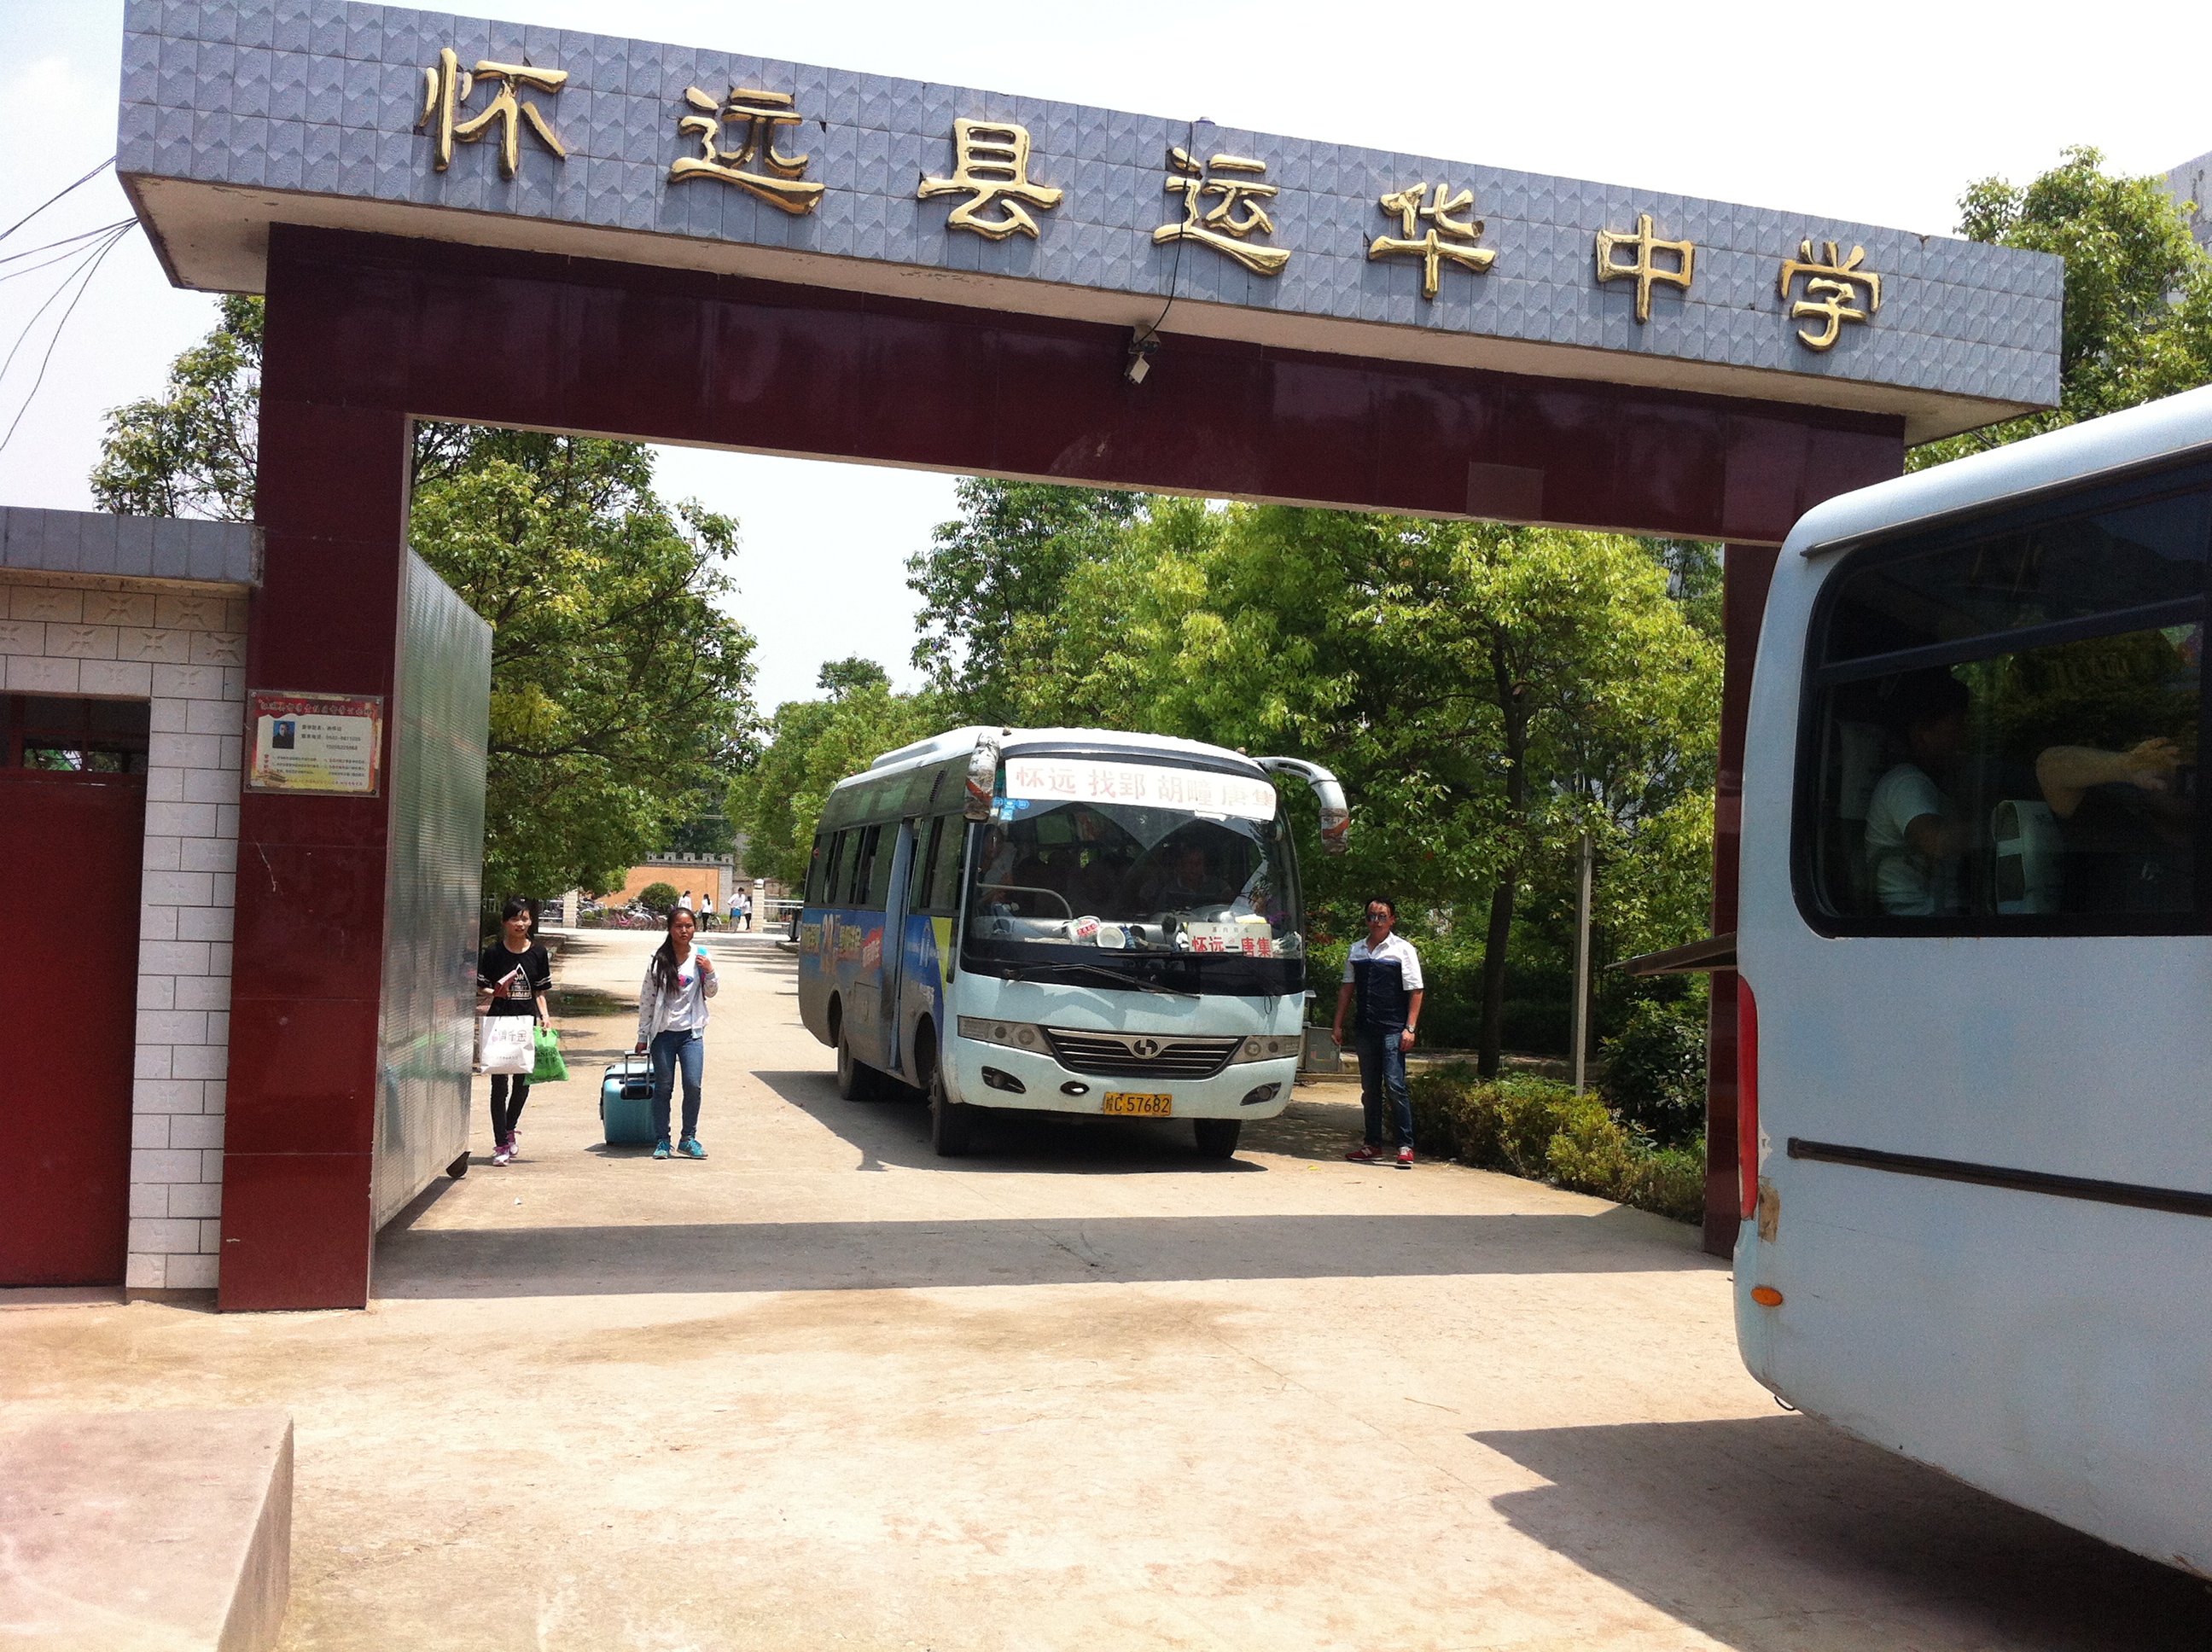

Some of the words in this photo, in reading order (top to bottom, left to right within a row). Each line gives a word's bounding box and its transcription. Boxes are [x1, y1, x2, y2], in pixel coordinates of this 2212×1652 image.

[420, 47, 1880, 351] 怀远县运华中学
[1016, 765, 1076, 794] 怀远
